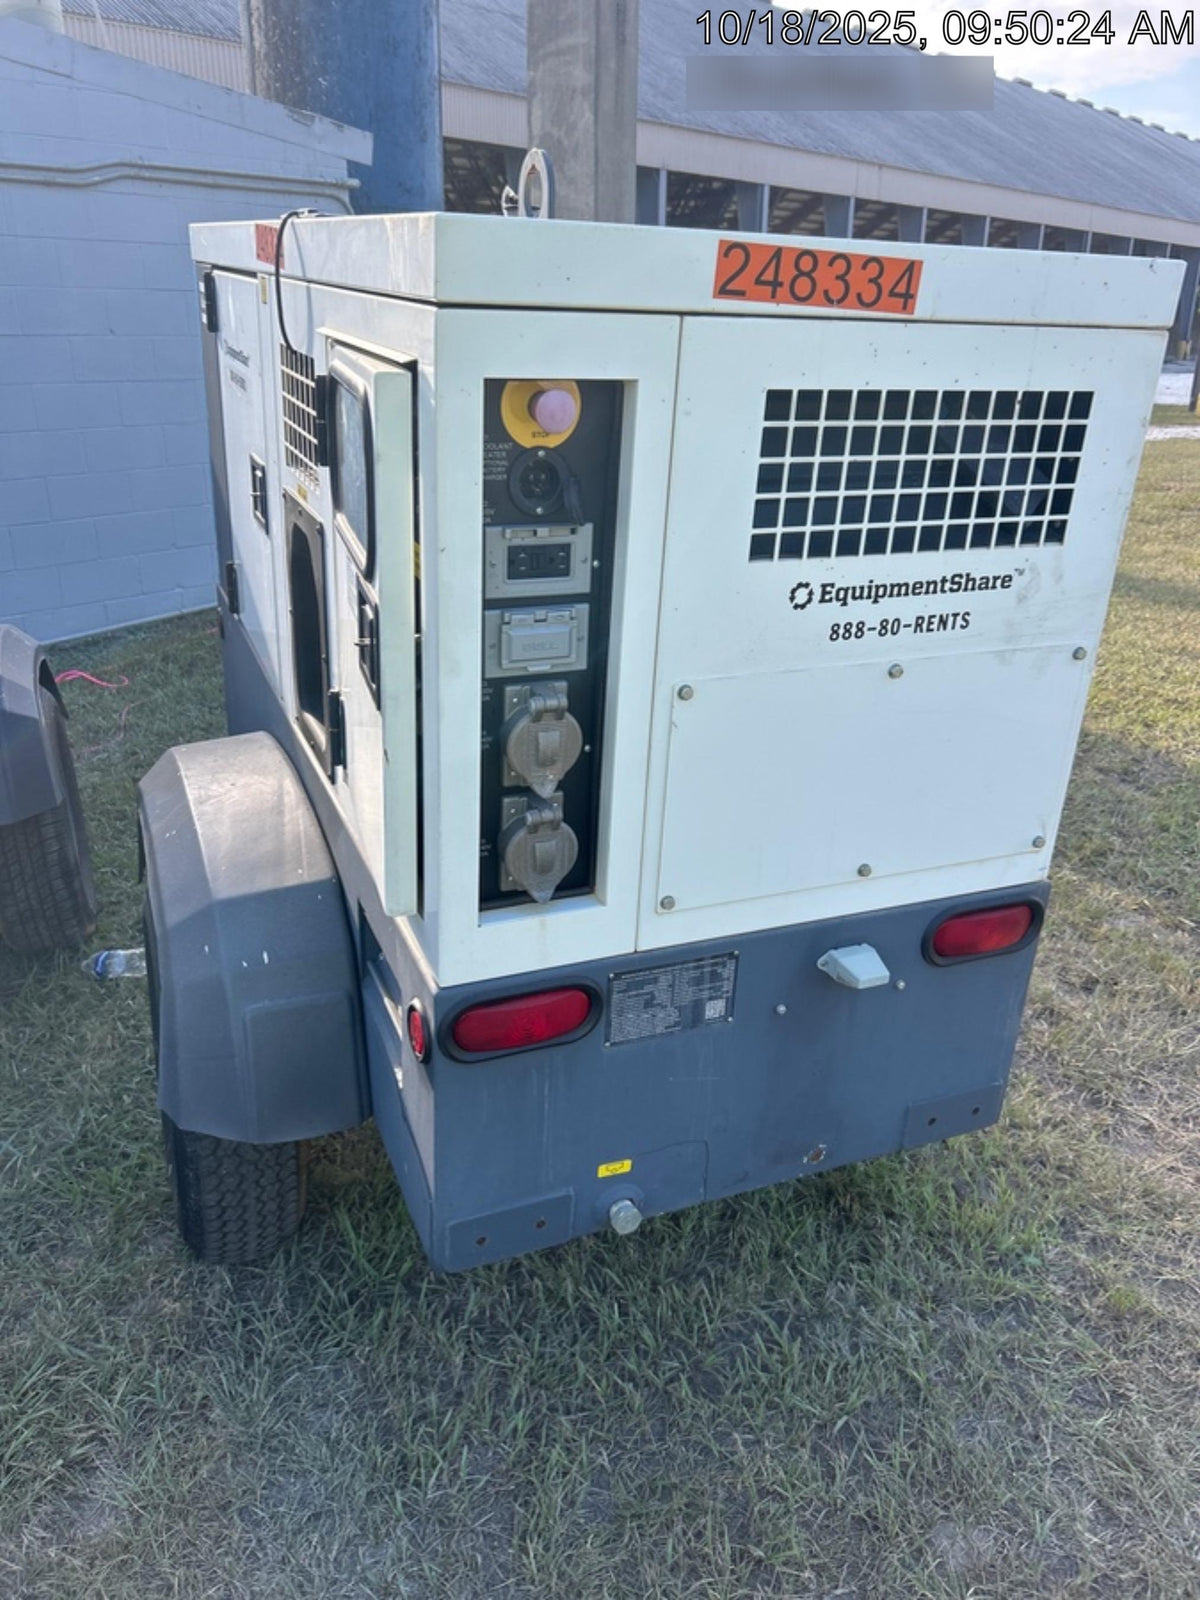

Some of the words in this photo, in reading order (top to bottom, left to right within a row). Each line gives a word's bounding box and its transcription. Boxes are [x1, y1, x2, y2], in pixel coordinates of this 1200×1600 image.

[717, 241, 917, 311] 248334
[818, 572, 1013, 607] EquipmentShare
[828, 611, 972, 643] 888-80-RENTS
